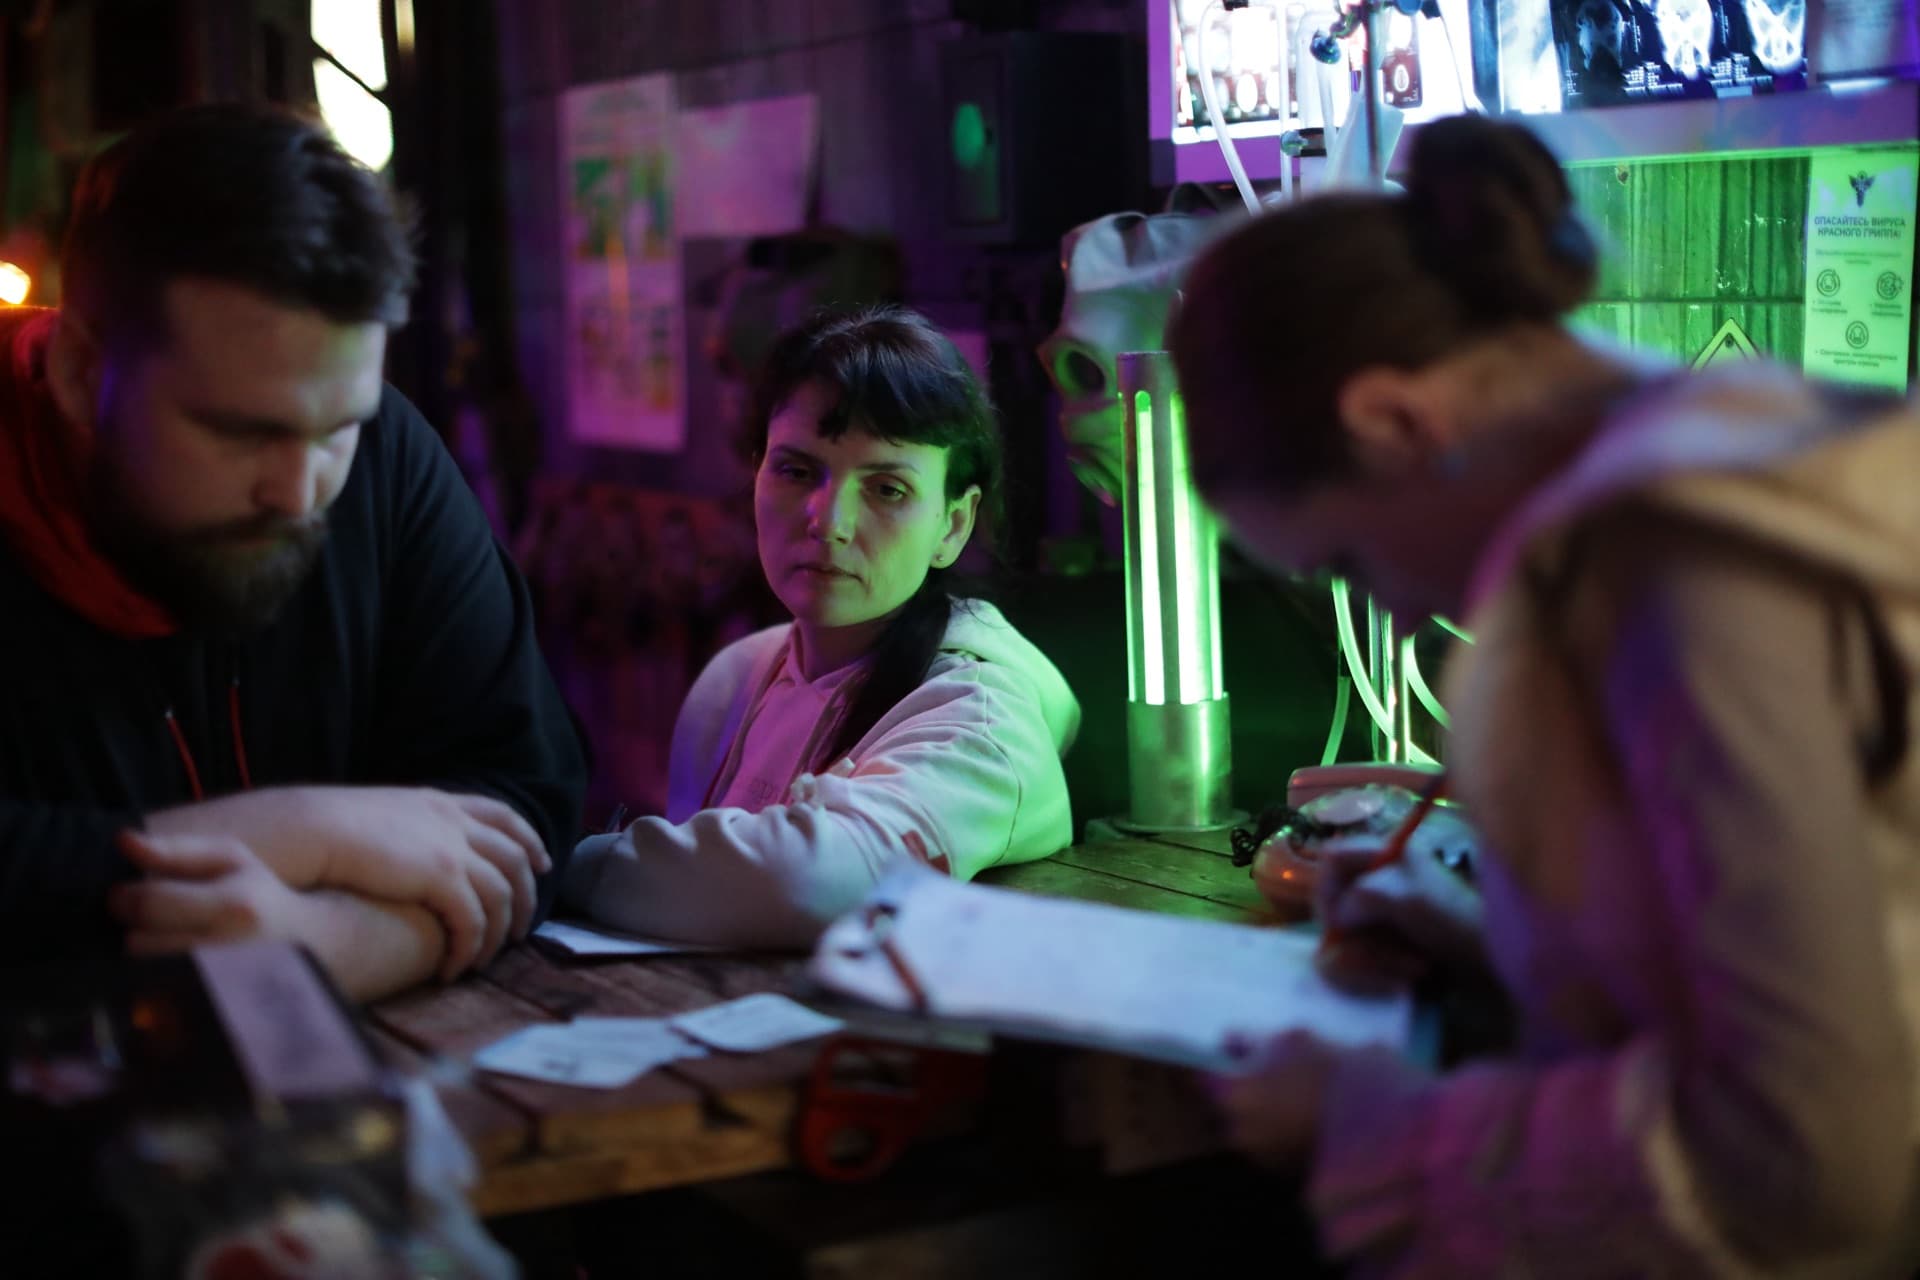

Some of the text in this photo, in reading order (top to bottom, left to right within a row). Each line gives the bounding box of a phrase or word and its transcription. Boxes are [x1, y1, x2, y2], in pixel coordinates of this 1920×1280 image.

[1815, 215, 1906, 227] ОПАСАЙТЕСЬ ВИРУСА
[1818, 227, 1861, 237] КРАСНОГО
